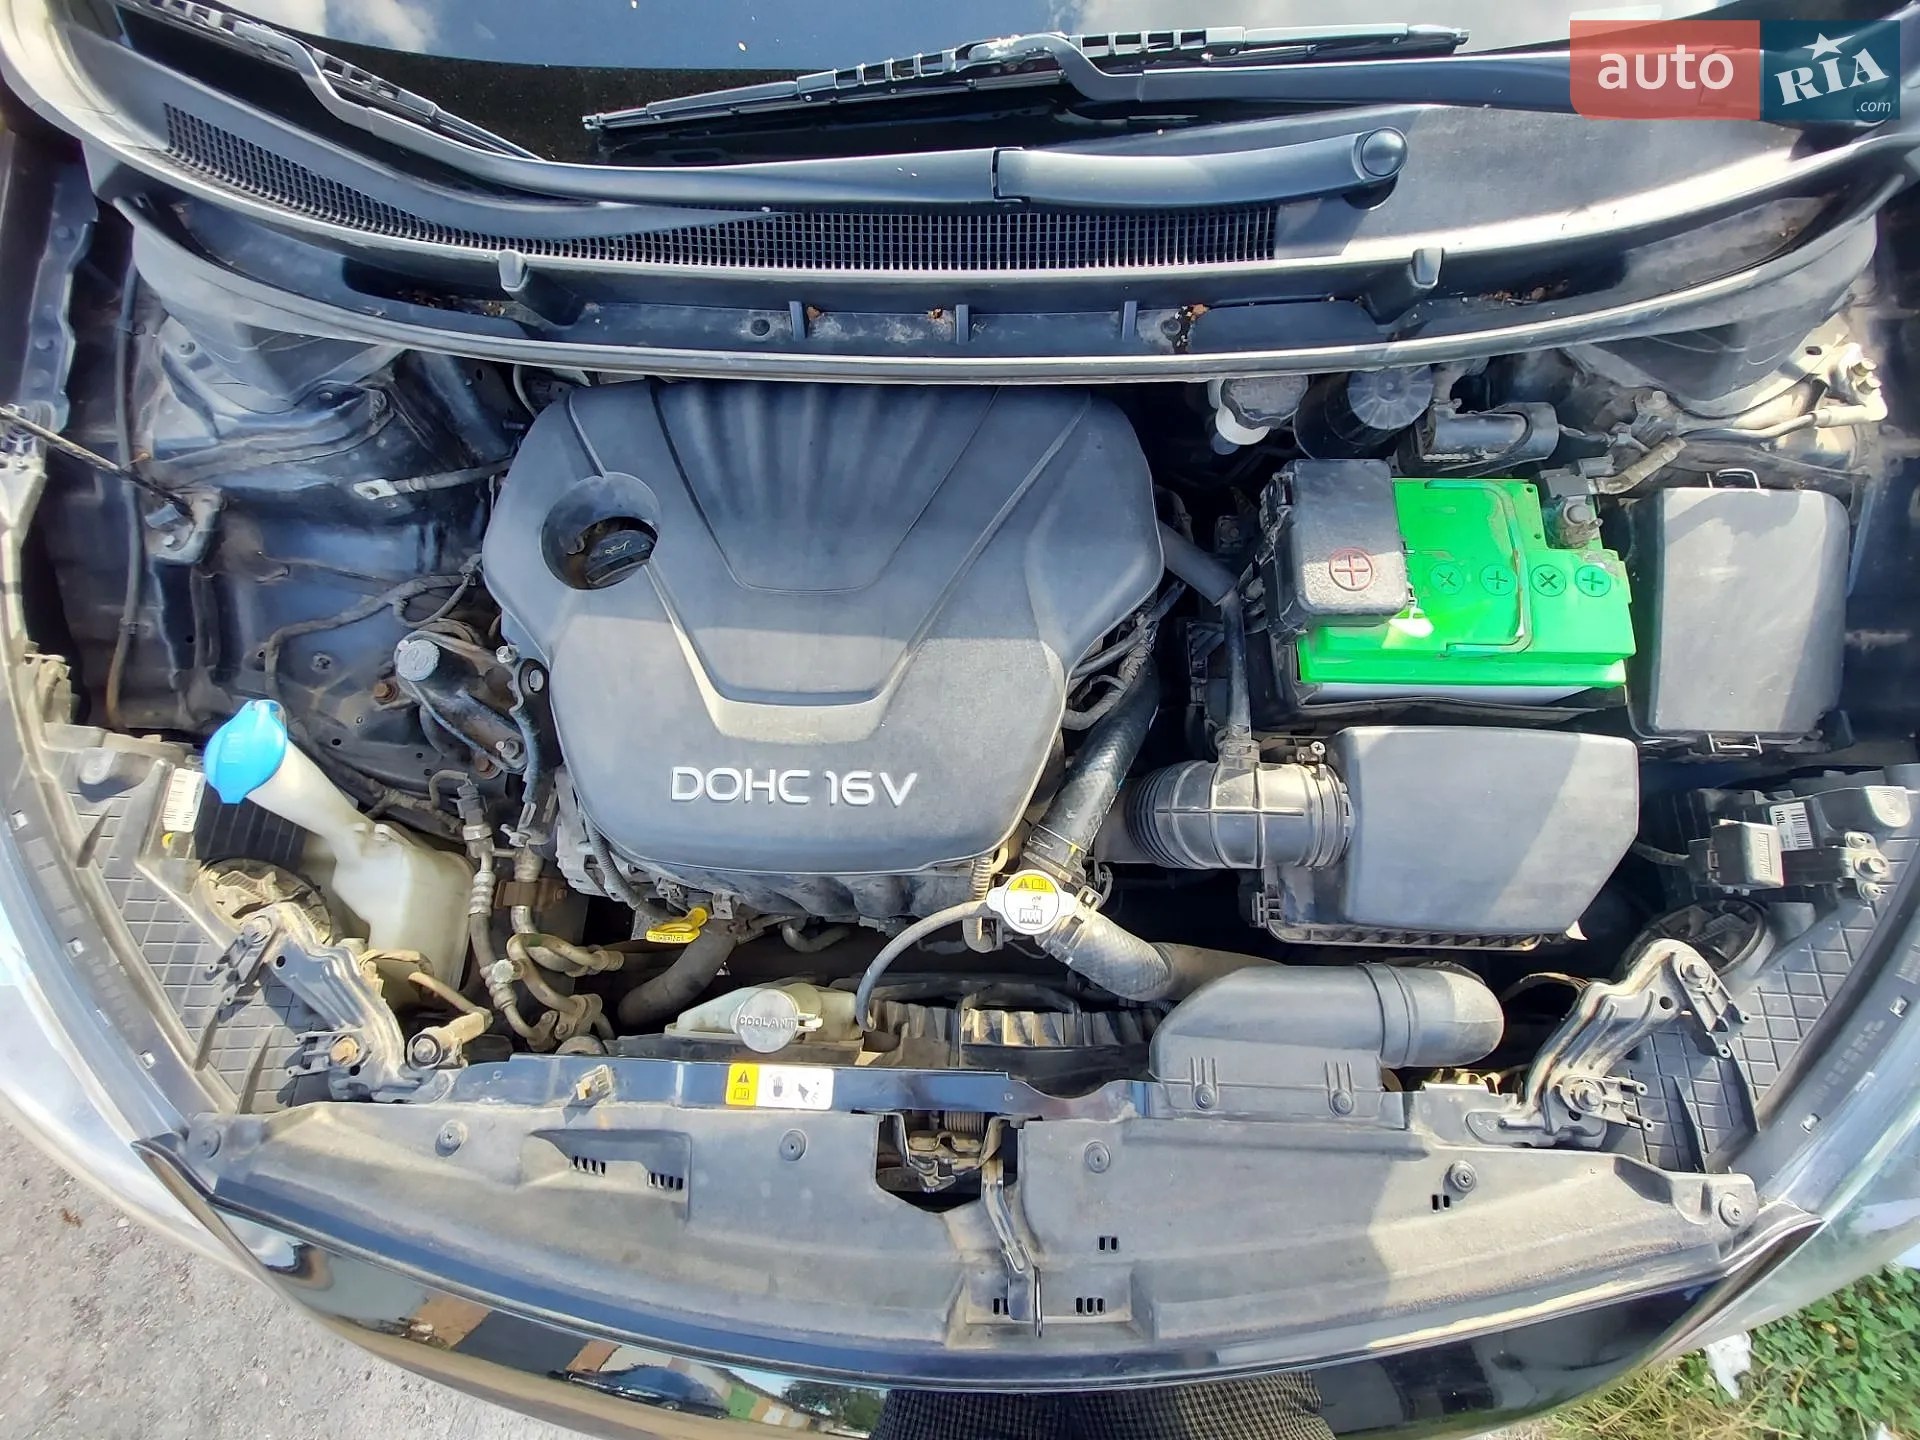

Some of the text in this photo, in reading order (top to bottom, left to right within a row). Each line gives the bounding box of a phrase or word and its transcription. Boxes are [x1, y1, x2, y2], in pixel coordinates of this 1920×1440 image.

[671, 766, 918, 807] DOHC 16V
[739, 1015, 796, 1029] COOLANT
